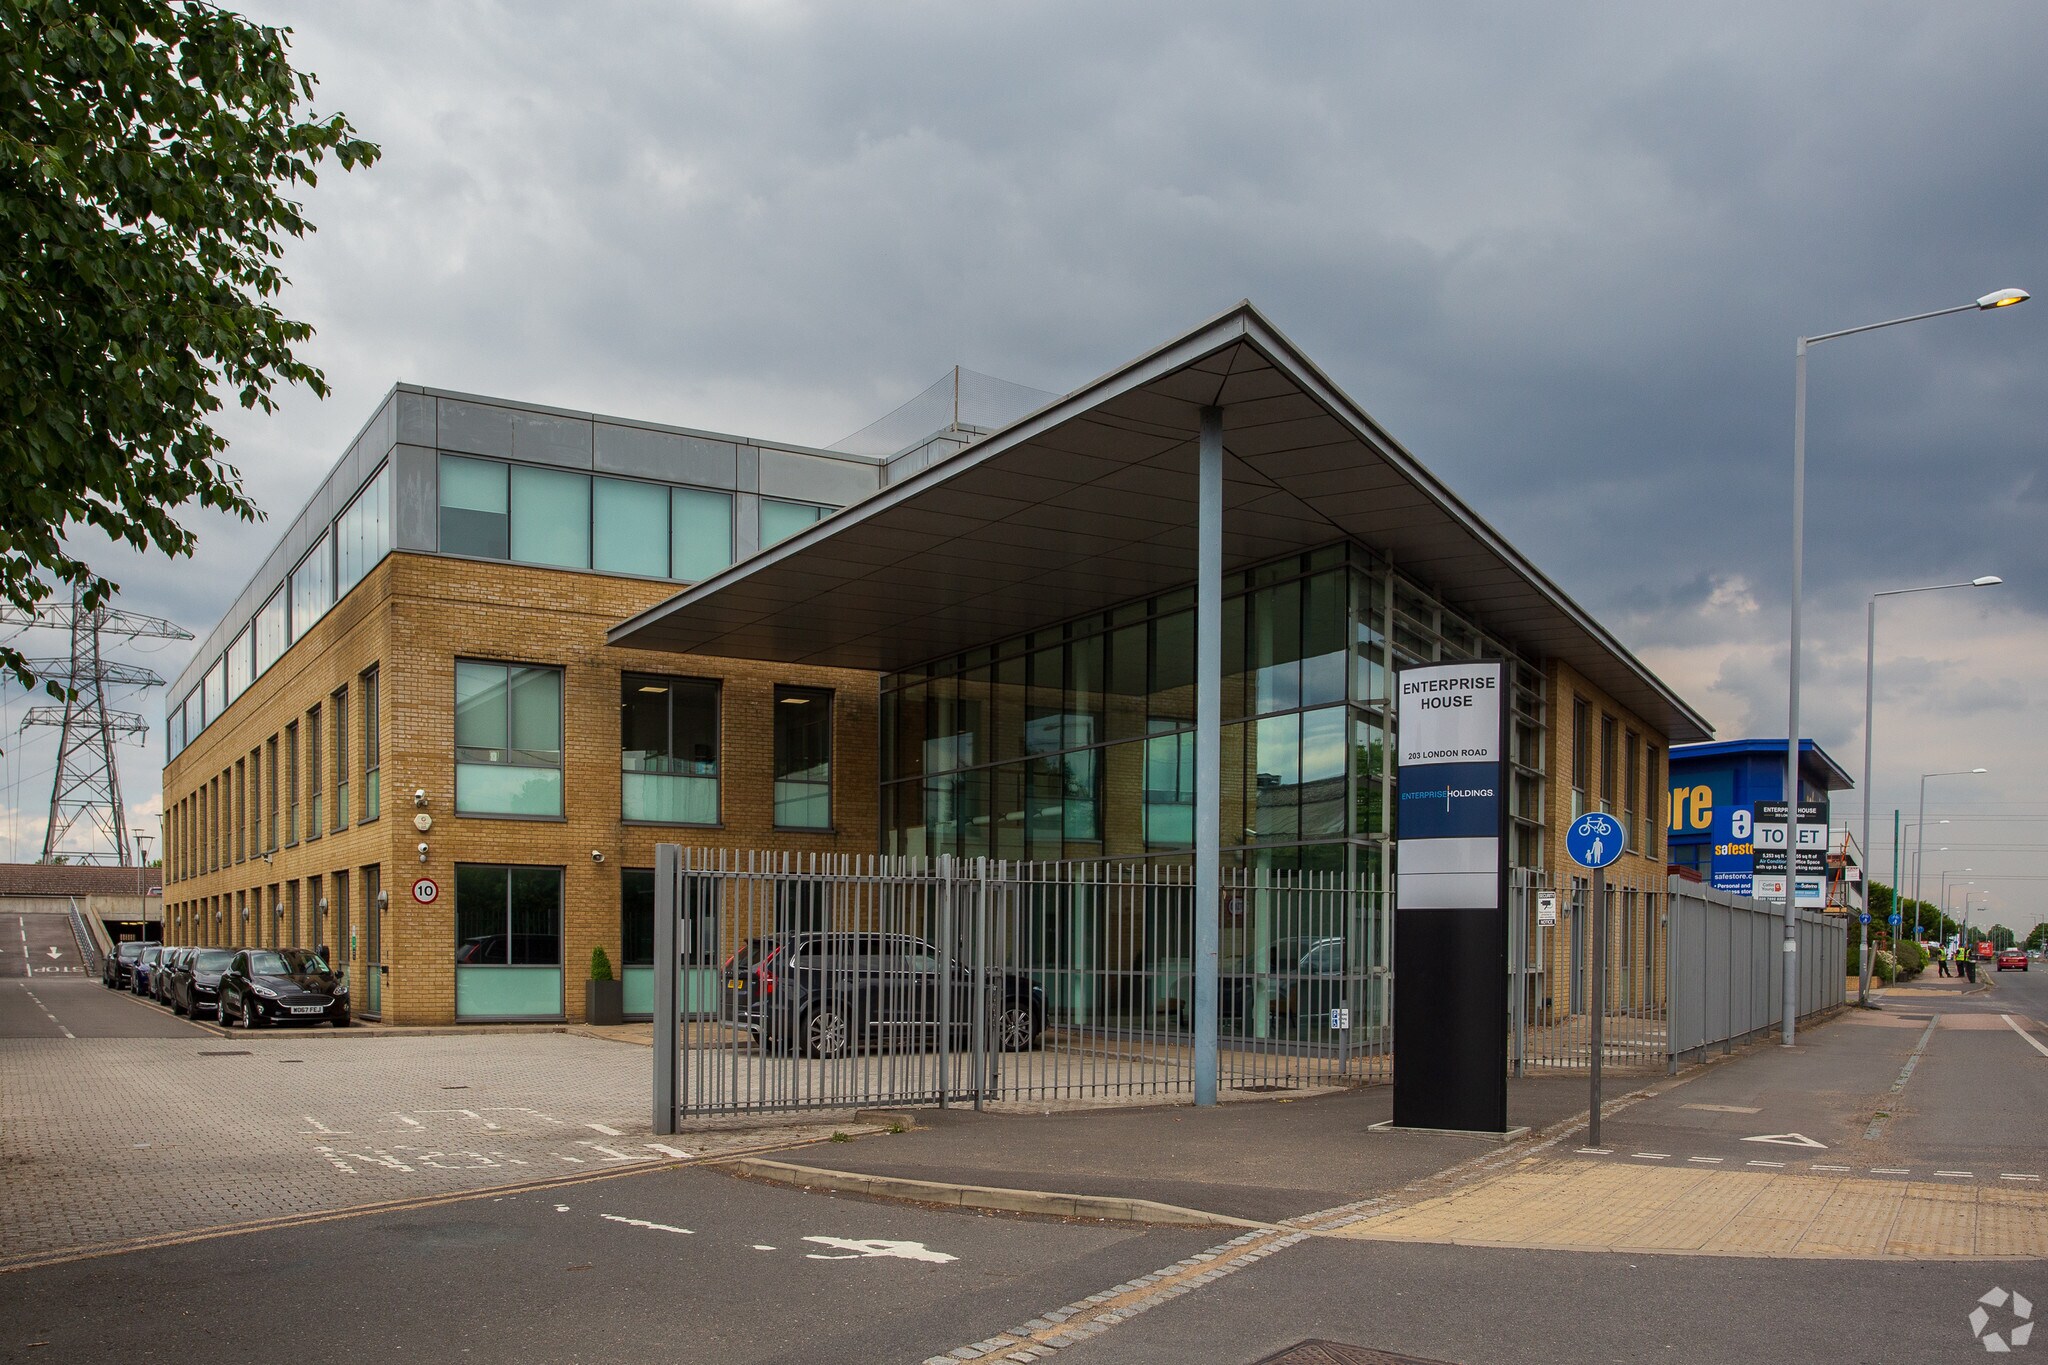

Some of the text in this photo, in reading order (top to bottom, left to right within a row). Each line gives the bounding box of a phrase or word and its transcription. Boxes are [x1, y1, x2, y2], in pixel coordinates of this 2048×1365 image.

[1403, 677, 1495, 694] ENTERPRISE
[1421, 695, 1473, 709] HOUSE
[1408, 748, 1488, 760] 203 LONDON ROAD
[1762, 829, 1820, 844] TO ET
[418, 886, 433, 896] 10
